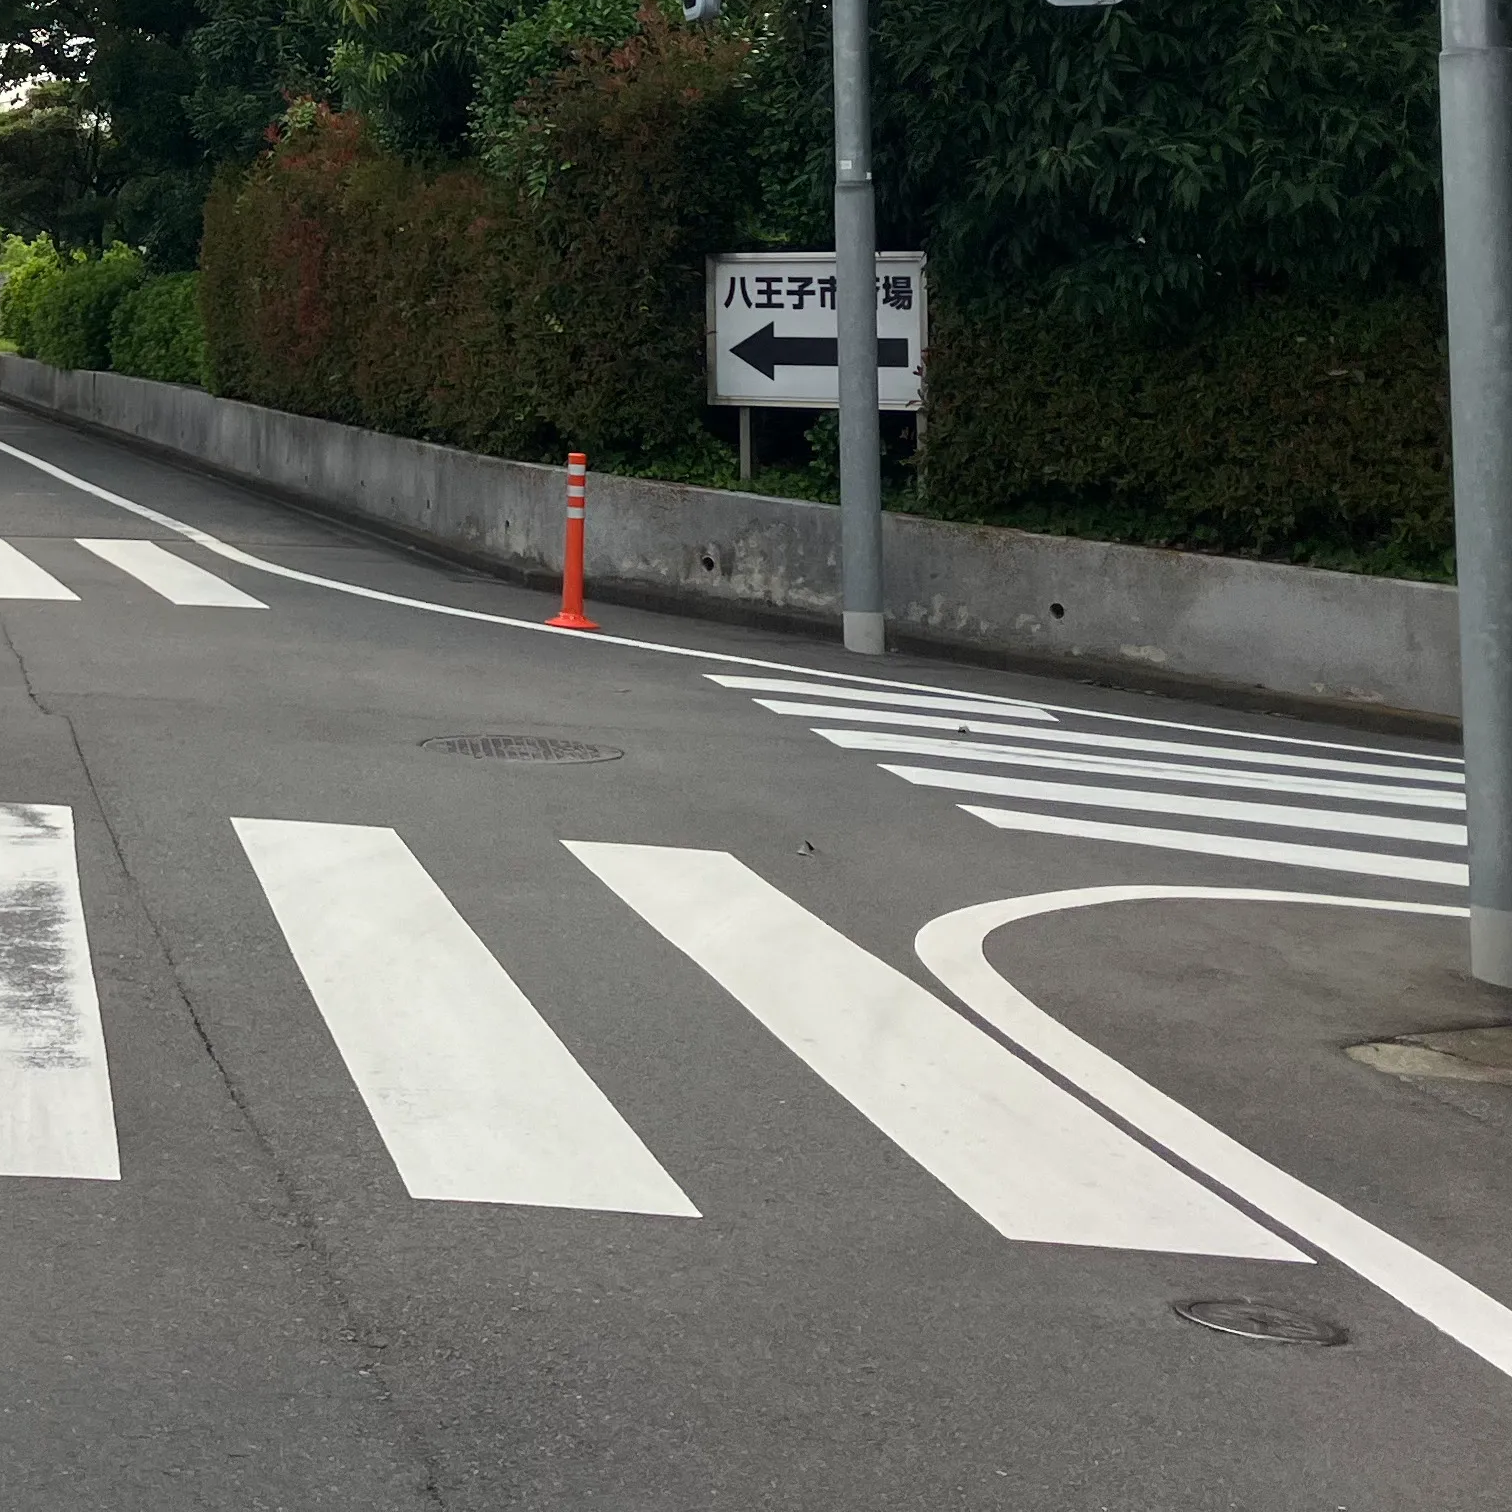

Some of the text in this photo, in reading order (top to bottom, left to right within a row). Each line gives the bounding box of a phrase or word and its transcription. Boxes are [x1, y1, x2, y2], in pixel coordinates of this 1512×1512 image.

[724, 275, 914, 311] 八王子市場
